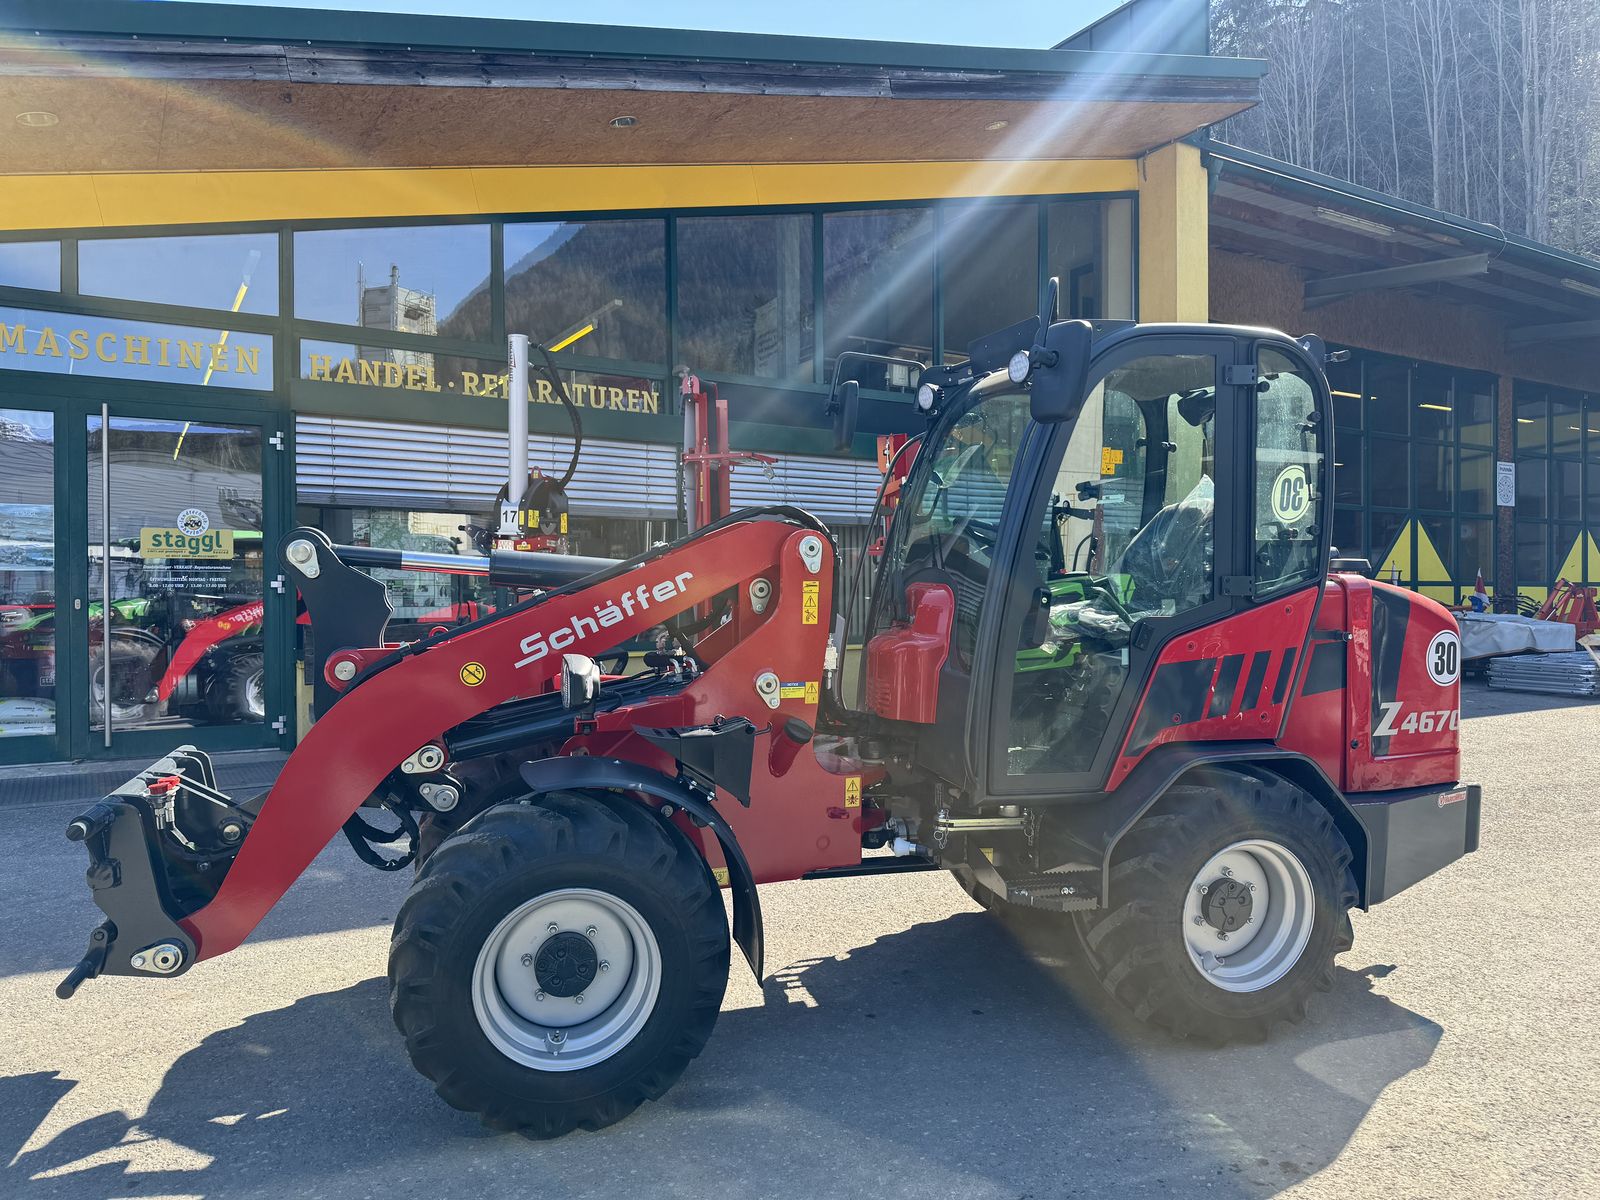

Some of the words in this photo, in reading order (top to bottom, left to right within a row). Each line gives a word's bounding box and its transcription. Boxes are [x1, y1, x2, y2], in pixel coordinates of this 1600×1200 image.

[0, 322, 261, 375] MASCHINEN
[308, 353, 442, 393] HANDEL
[502, 510, 517, 523] 17
[152, 531, 222, 555] staggl
[514, 571, 694, 669] Schäffer
[1434, 641, 1457, 676] 30
